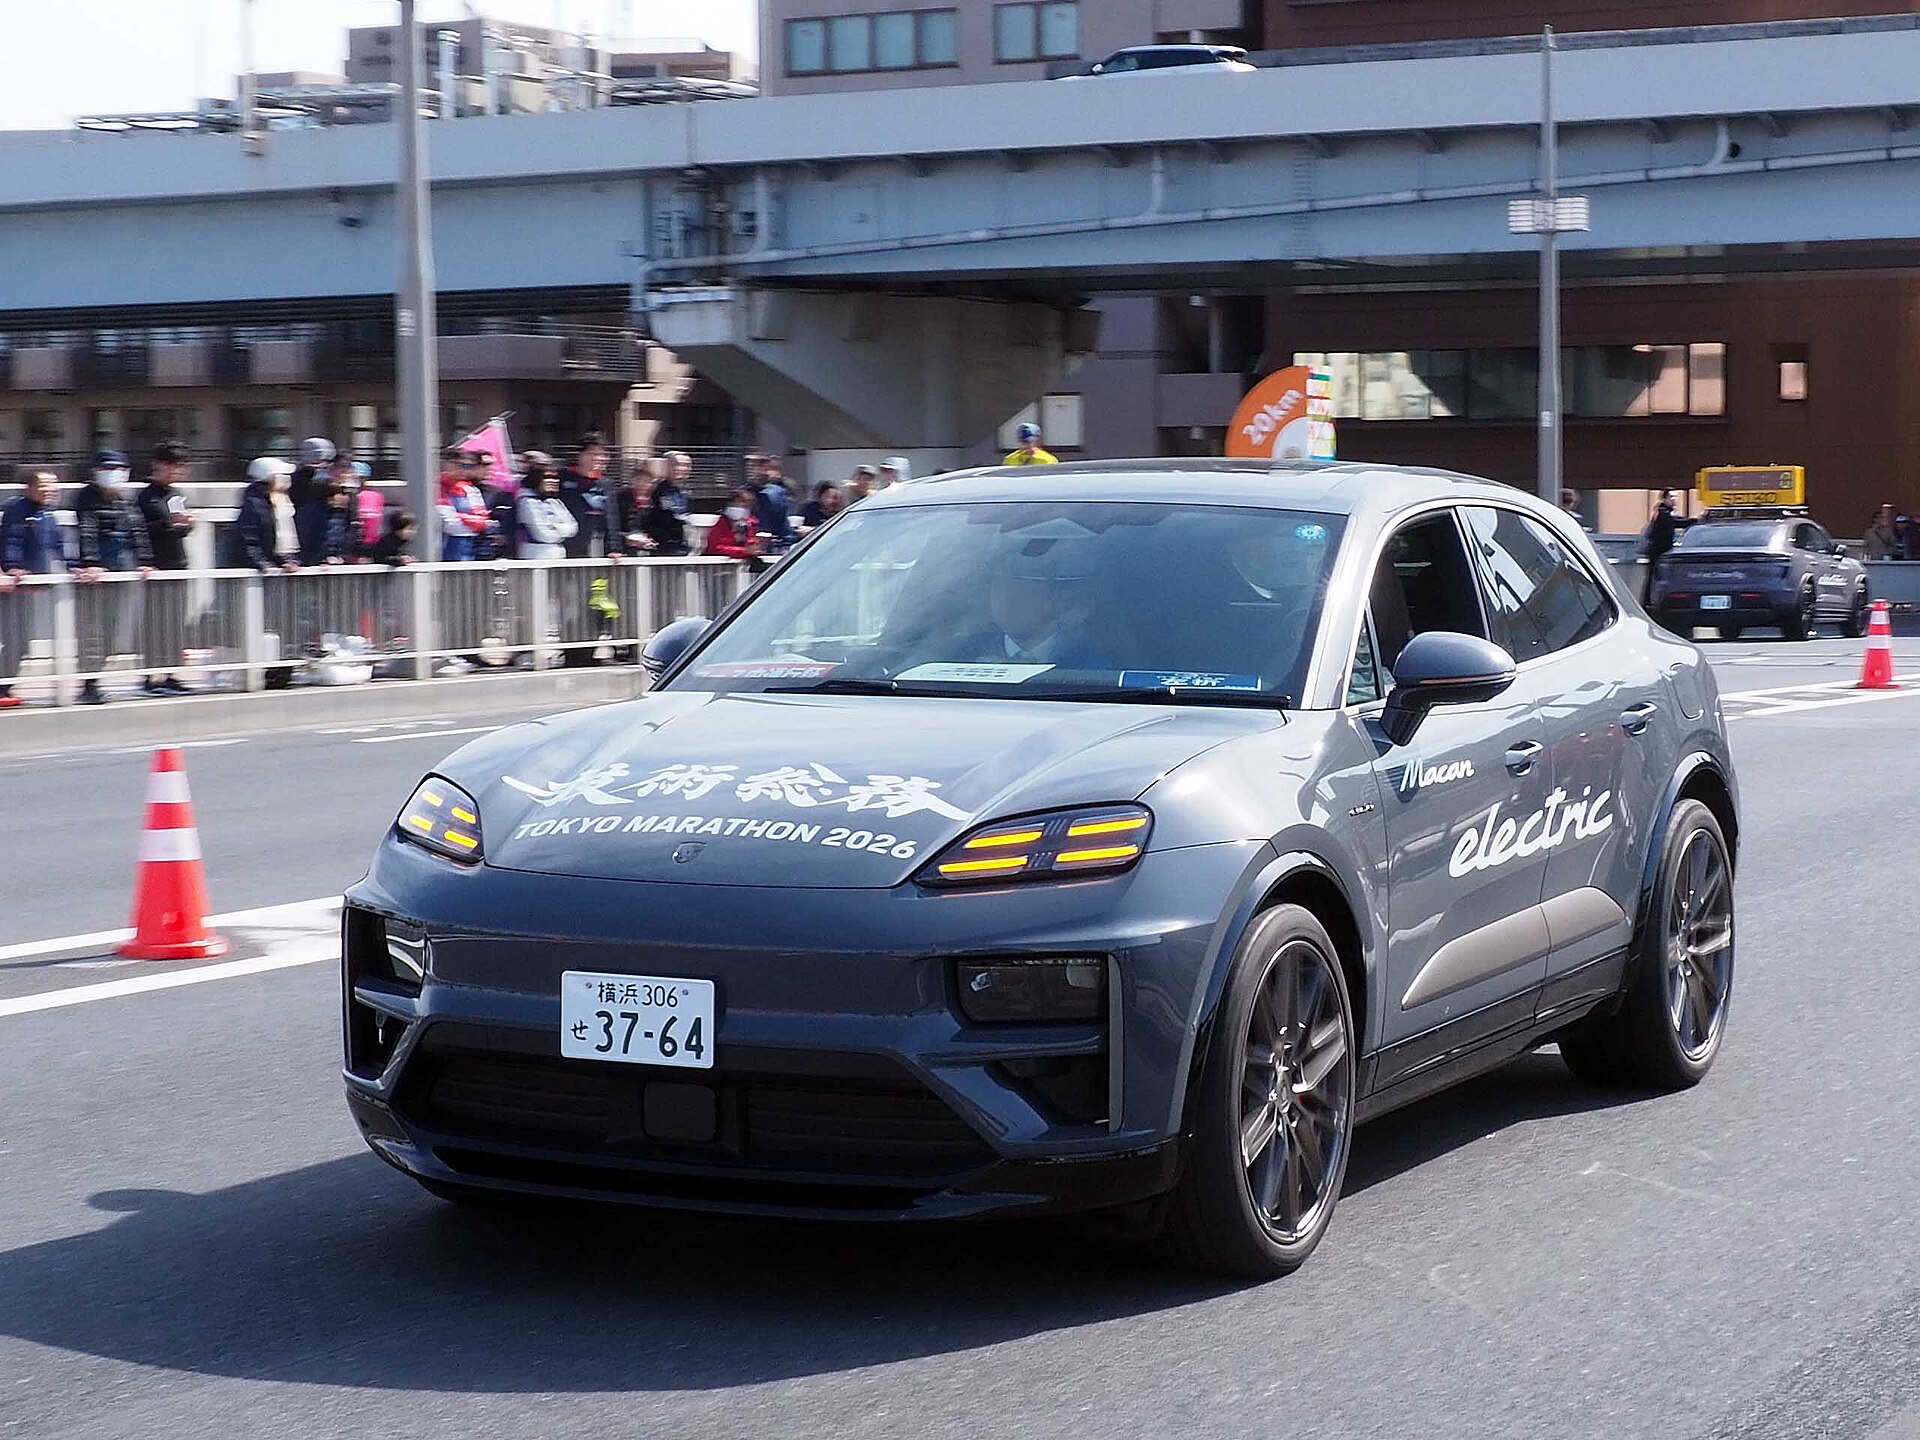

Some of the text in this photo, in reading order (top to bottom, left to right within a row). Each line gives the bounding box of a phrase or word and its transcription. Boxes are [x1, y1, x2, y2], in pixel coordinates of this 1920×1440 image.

[1242, 389, 1303, 446] 20km
[1720, 492, 1777, 504] SEIKO
[1400, 758, 1475, 792] Macan
[513, 815, 918, 859] TOKYO MARATHON 2026
[1449, 786, 1613, 878] electric
[571, 1011, 704, 1060] せ 37-64
